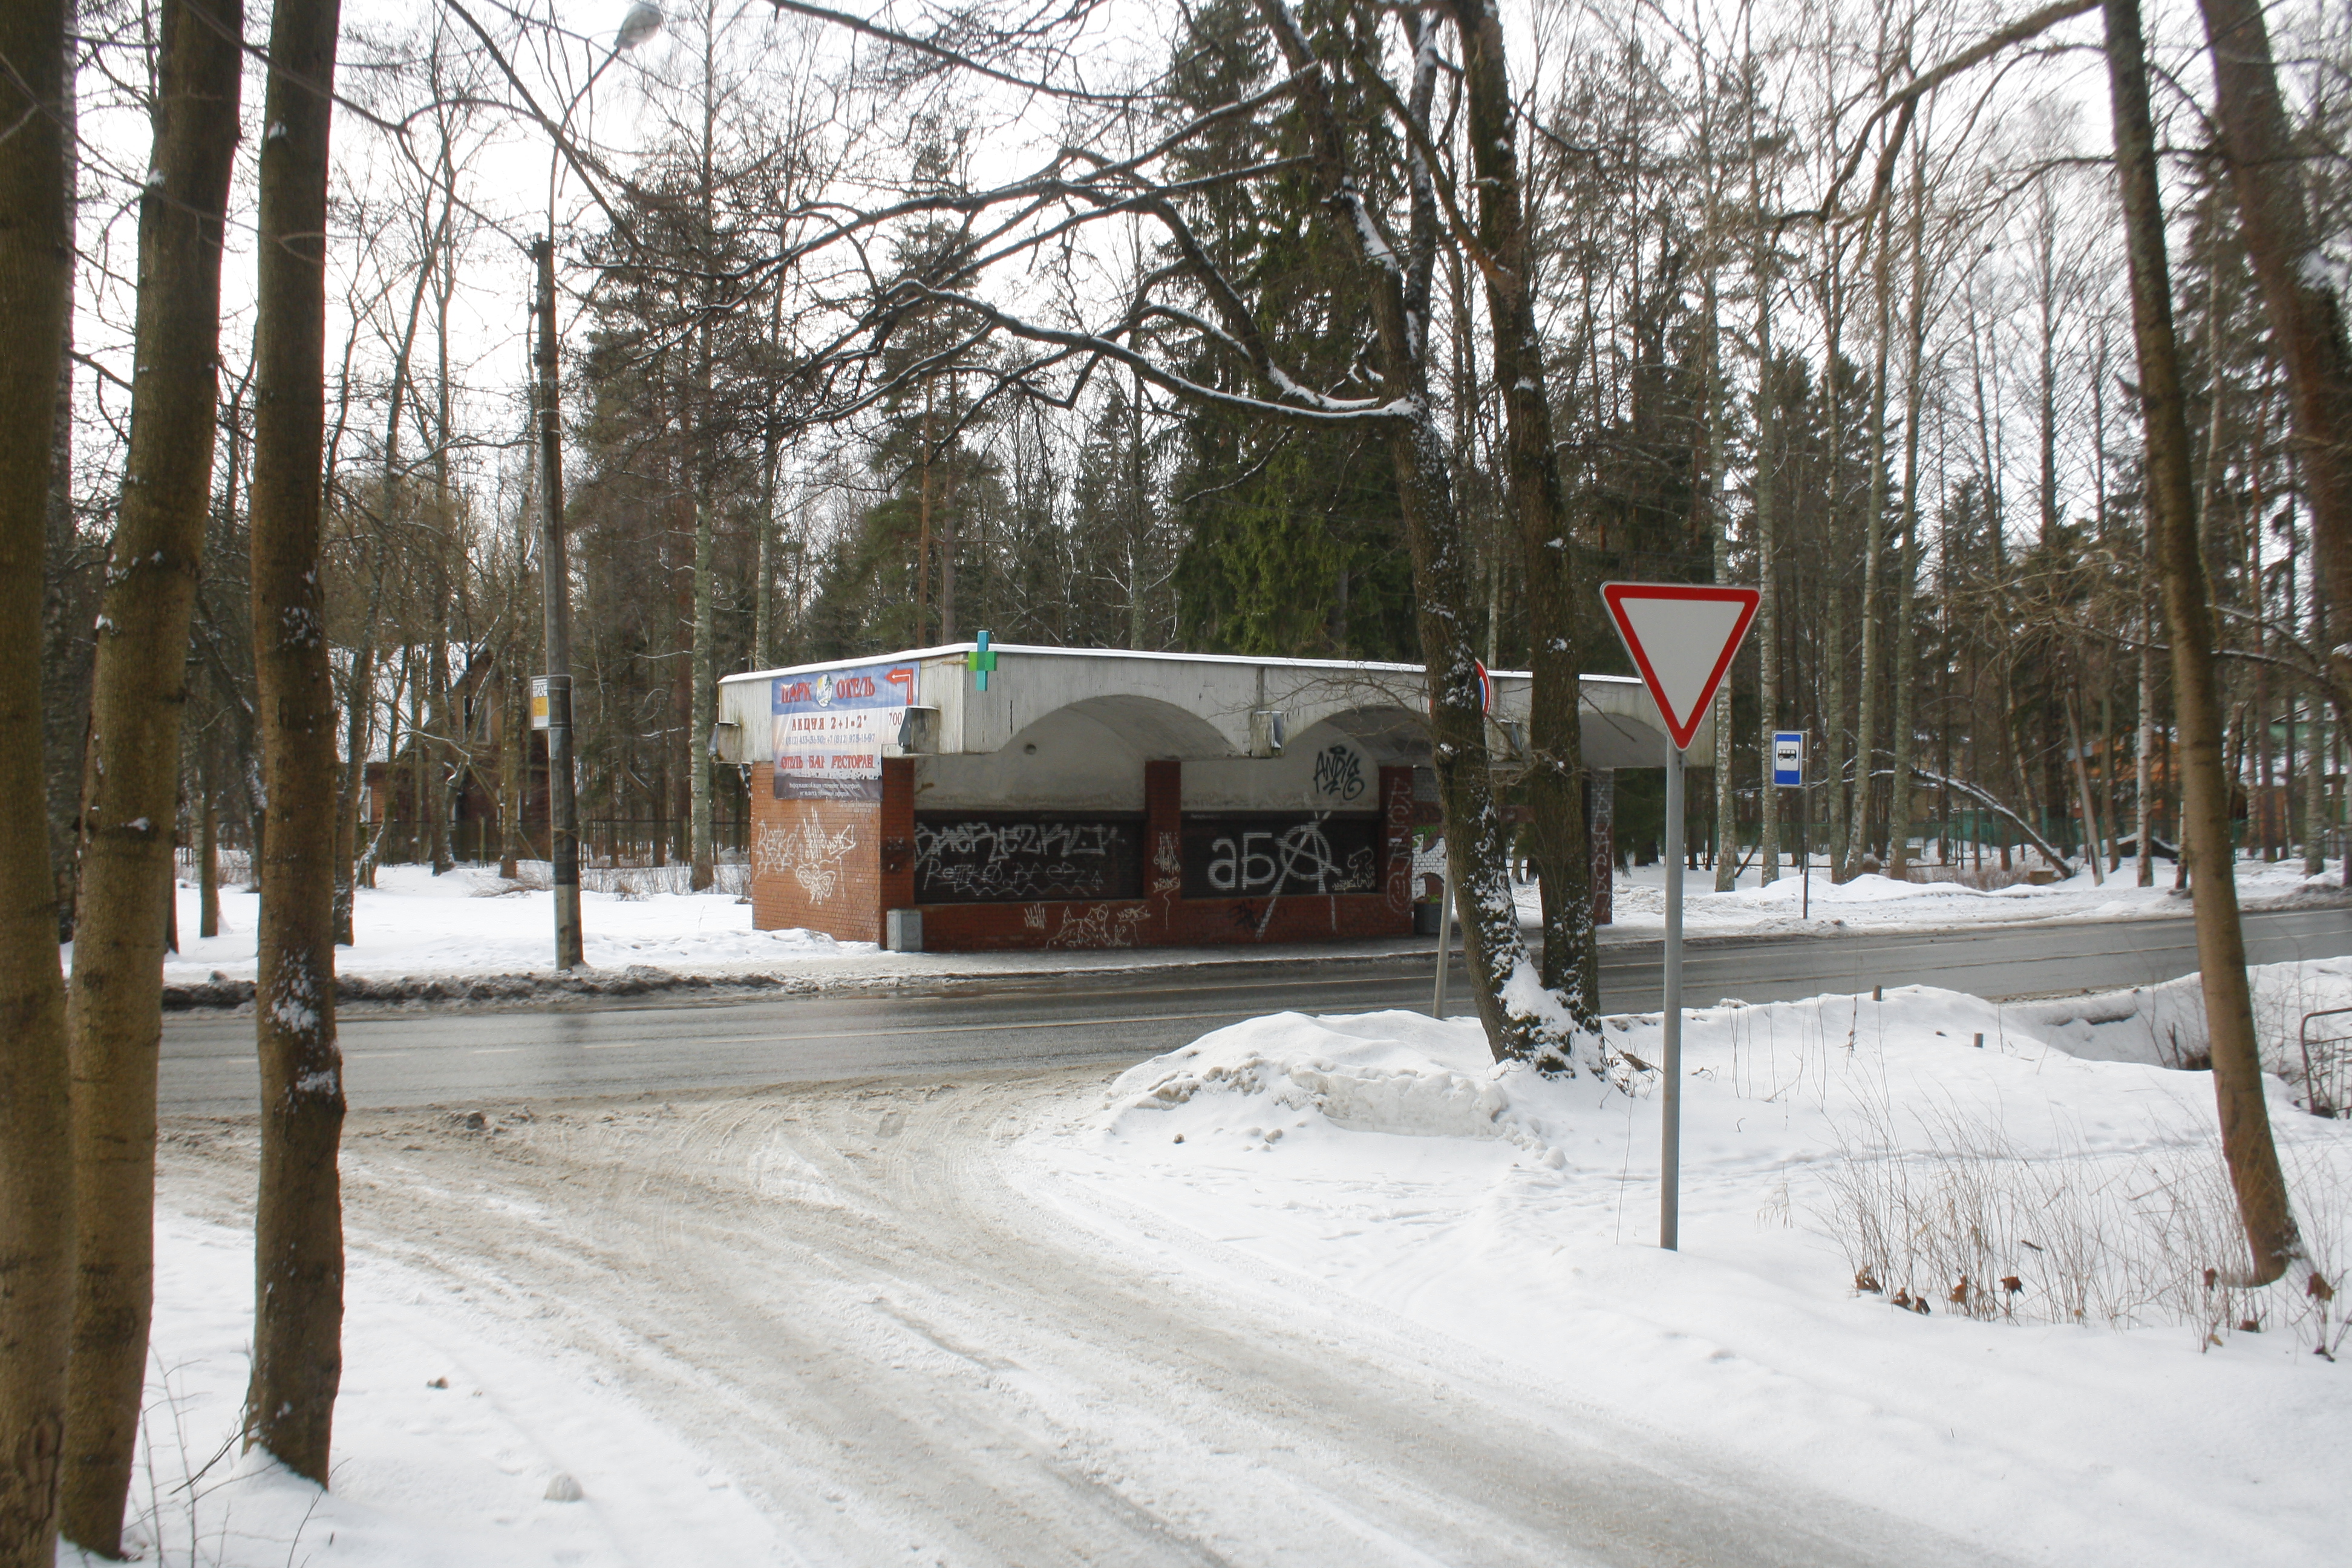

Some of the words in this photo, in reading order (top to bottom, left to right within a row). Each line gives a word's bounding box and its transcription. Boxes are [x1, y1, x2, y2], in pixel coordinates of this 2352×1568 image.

[781, 682, 812, 704] ПАРК
[836, 676, 876, 699] ОТЕЛЬ
[792, 717, 825, 733] АКЦИЯ
[780, 756, 803, 769] ОТЕЛЬ
[808, 756, 825, 769] БАР
[831, 754, 875, 769] РЕСТОРАН
